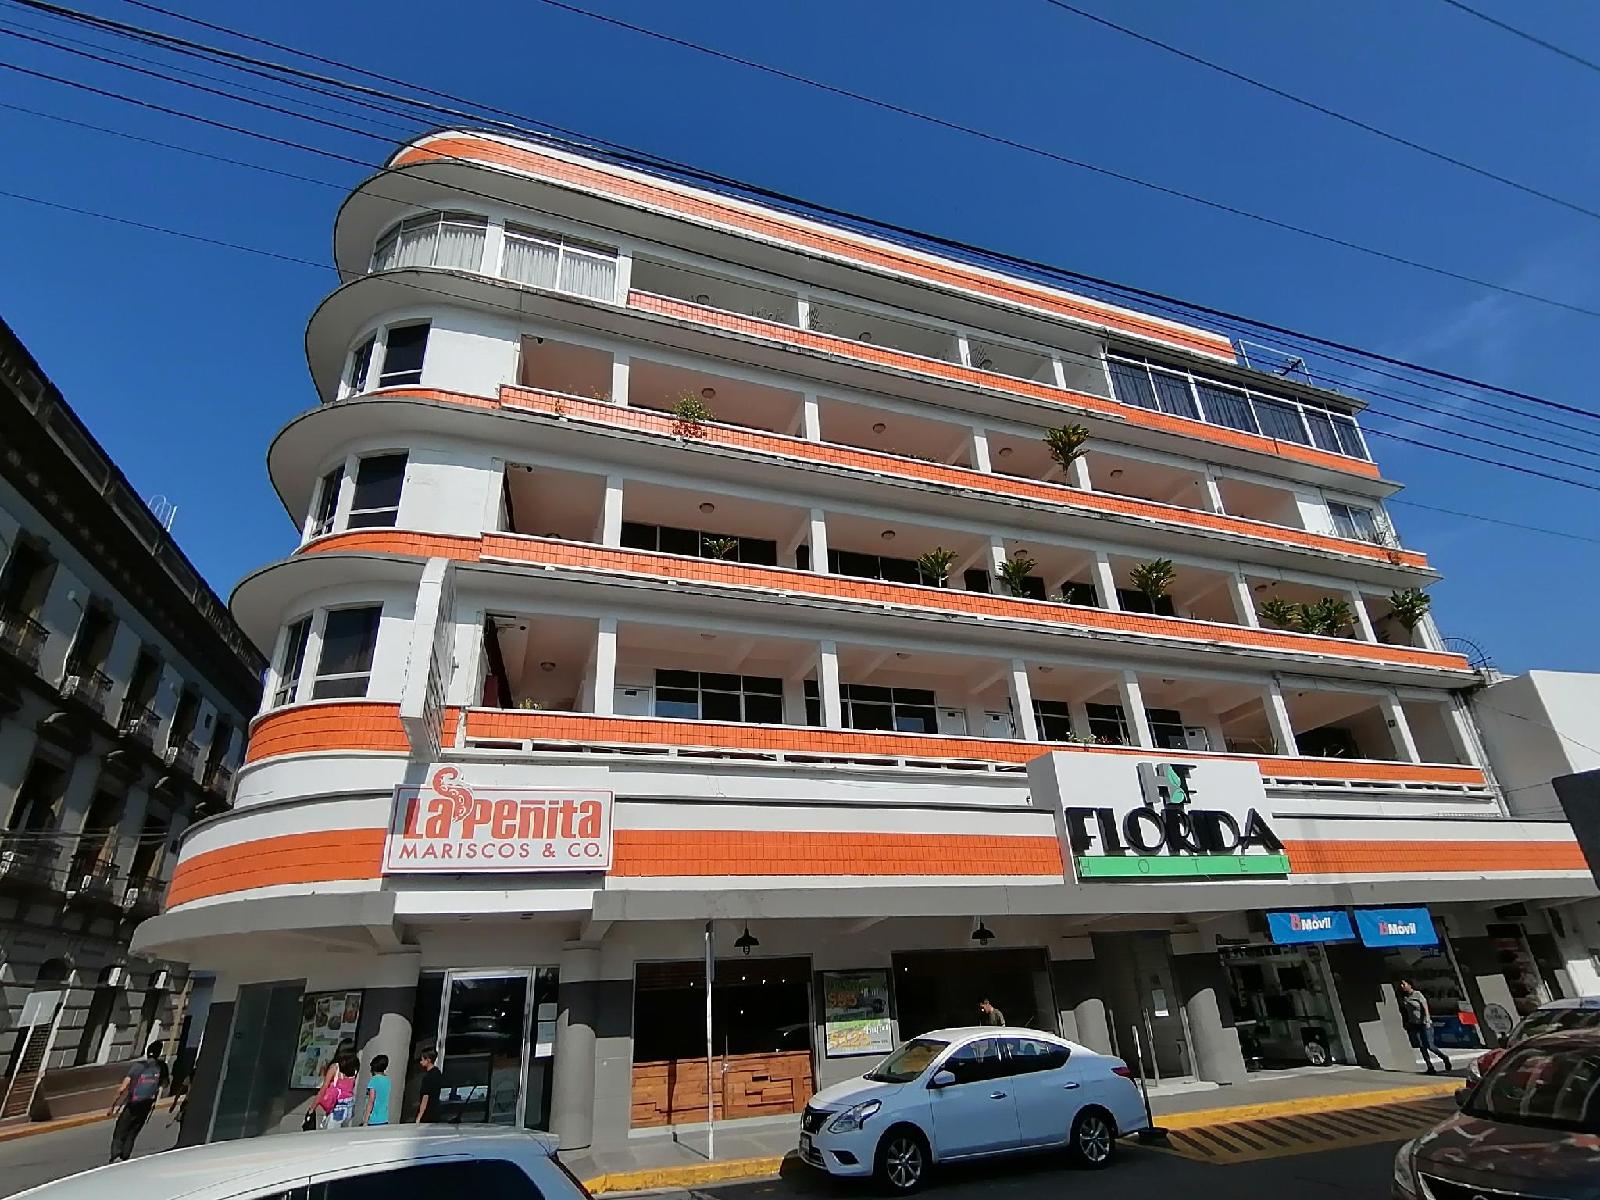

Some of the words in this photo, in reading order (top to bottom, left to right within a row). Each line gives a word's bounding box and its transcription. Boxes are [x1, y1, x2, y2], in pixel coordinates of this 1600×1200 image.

[403, 798, 454, 839] La
[1065, 806, 1286, 856] FLORIDA
[399, 842, 529, 859] MARISCOS
[542, 843, 556, 858] &
[568, 842, 602, 858] CO.
[1081, 857, 1288, 875] HOTEL
